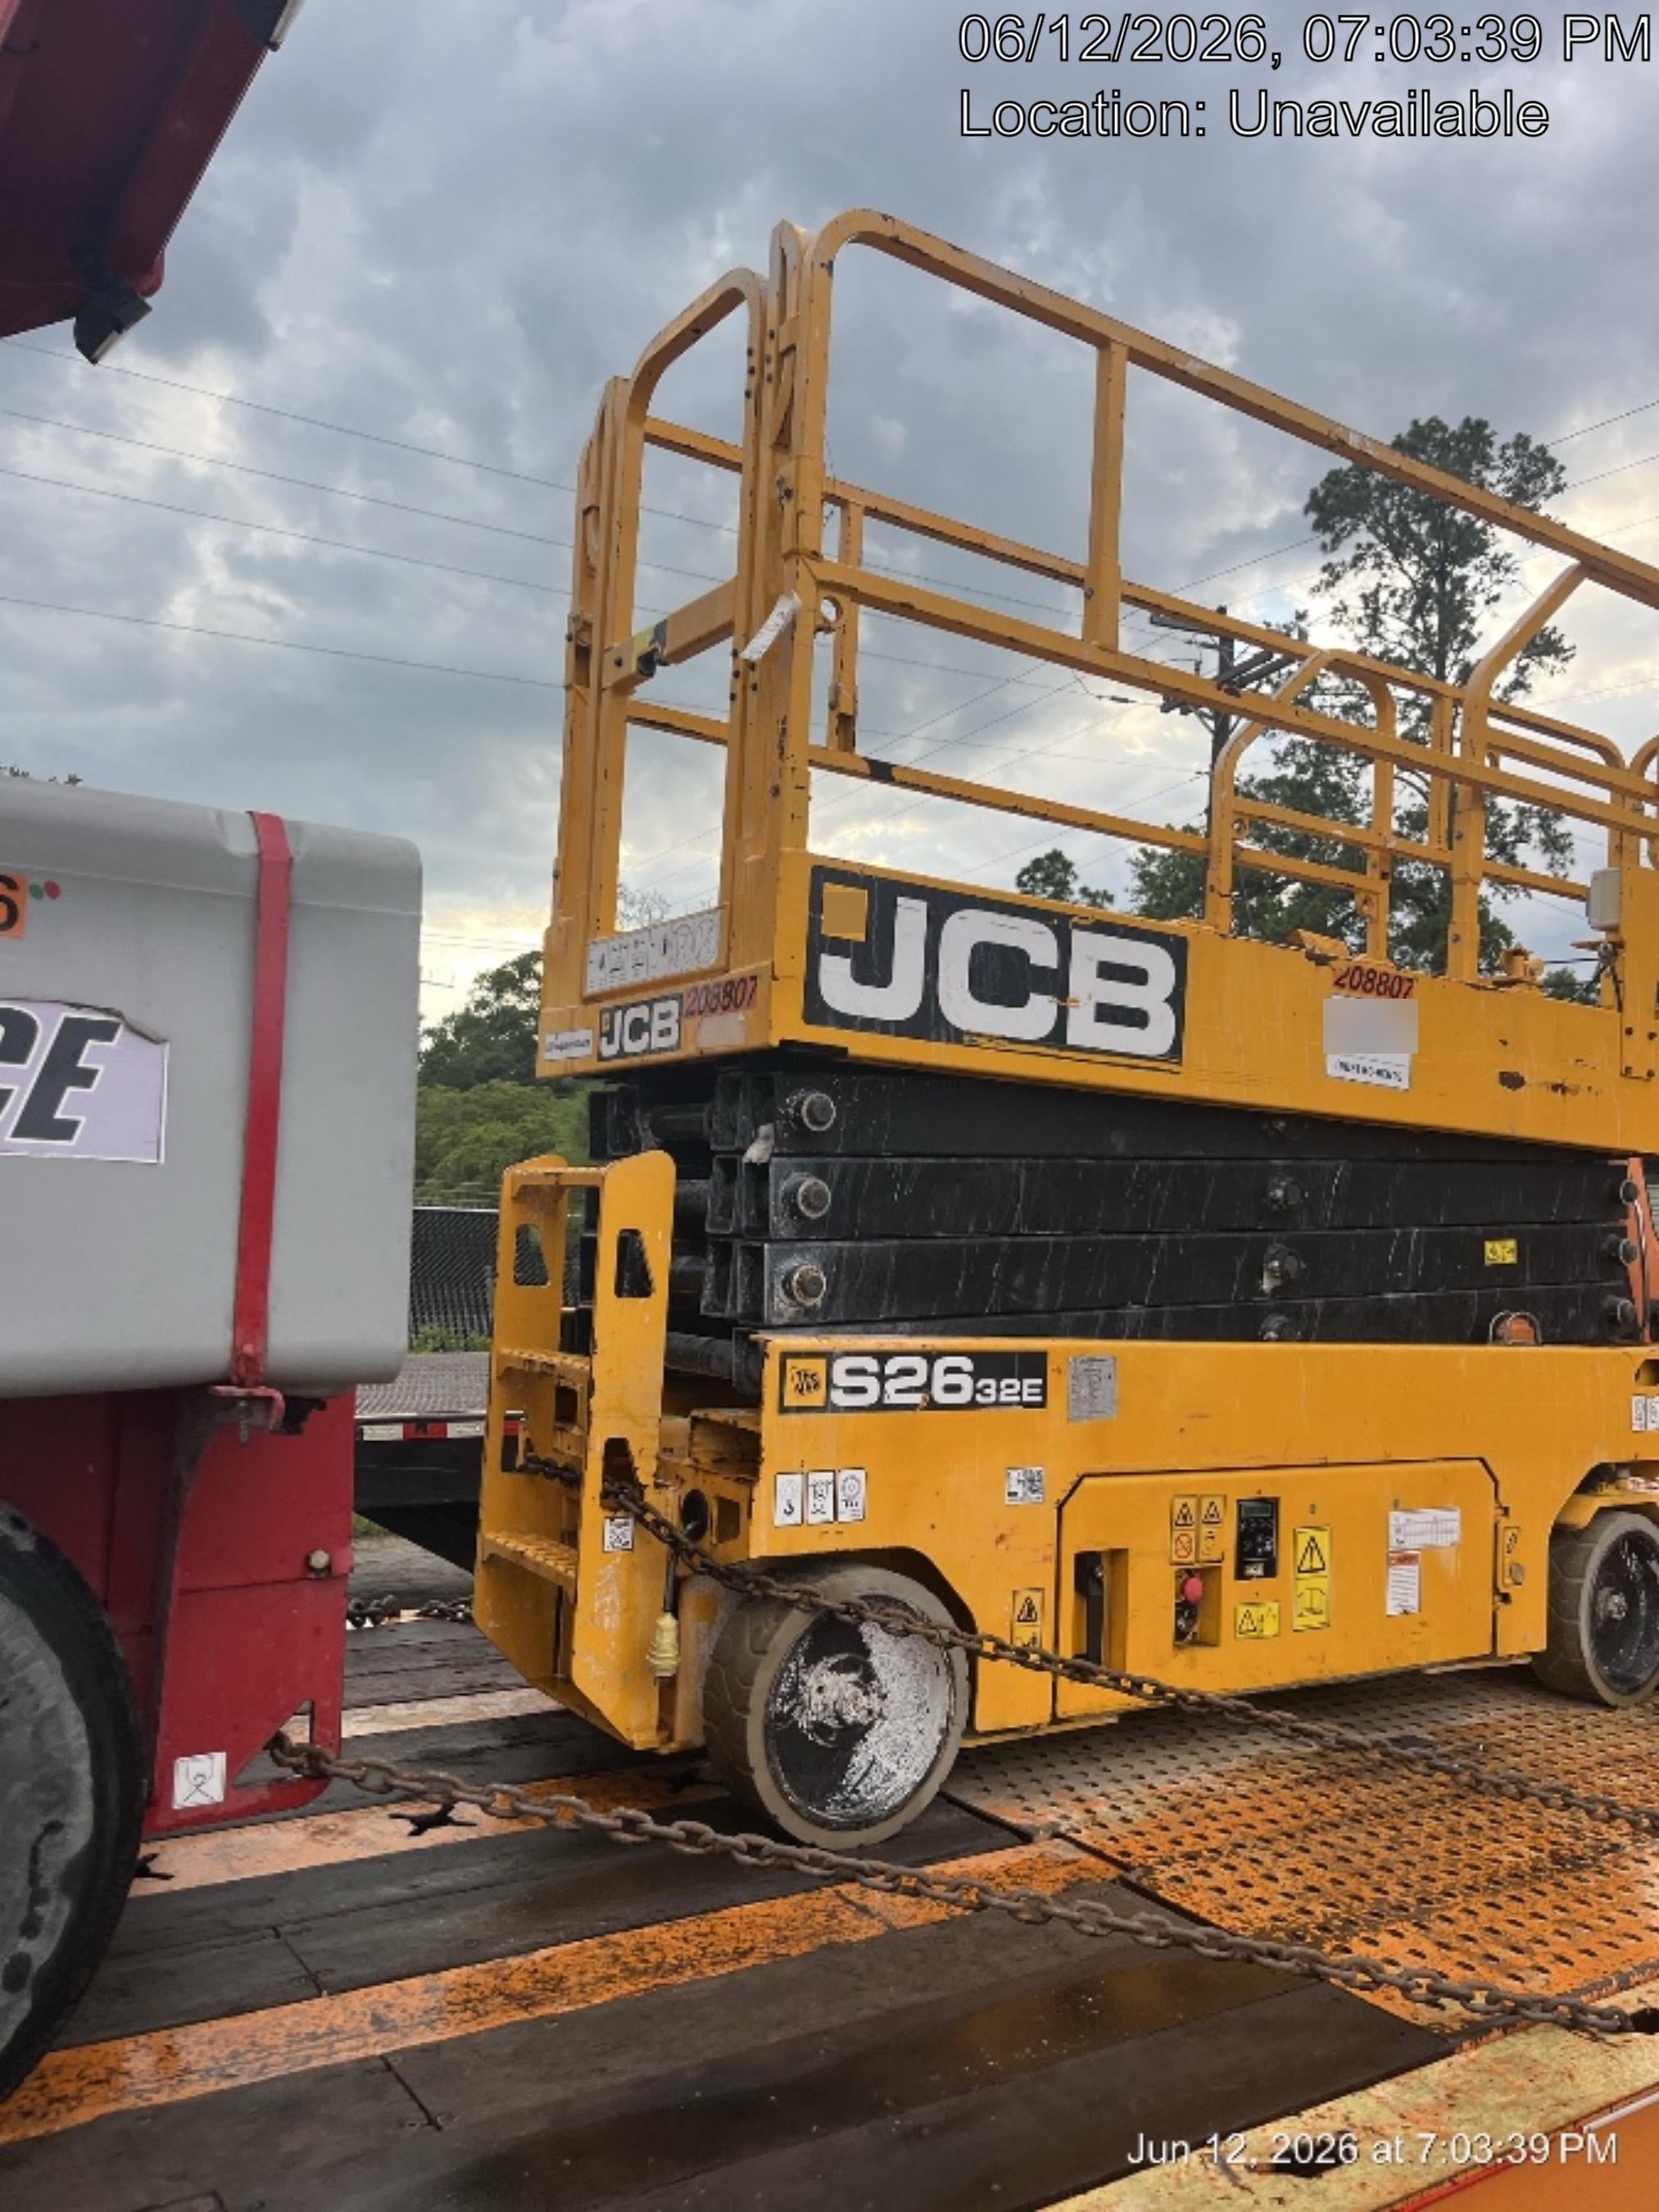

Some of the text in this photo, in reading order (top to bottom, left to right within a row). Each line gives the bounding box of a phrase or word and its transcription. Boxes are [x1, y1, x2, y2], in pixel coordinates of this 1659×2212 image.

[819, 896, 1176, 1057] JCB
[1335, 966, 1415, 999] 208807
[601, 999, 679, 1058] JCB
